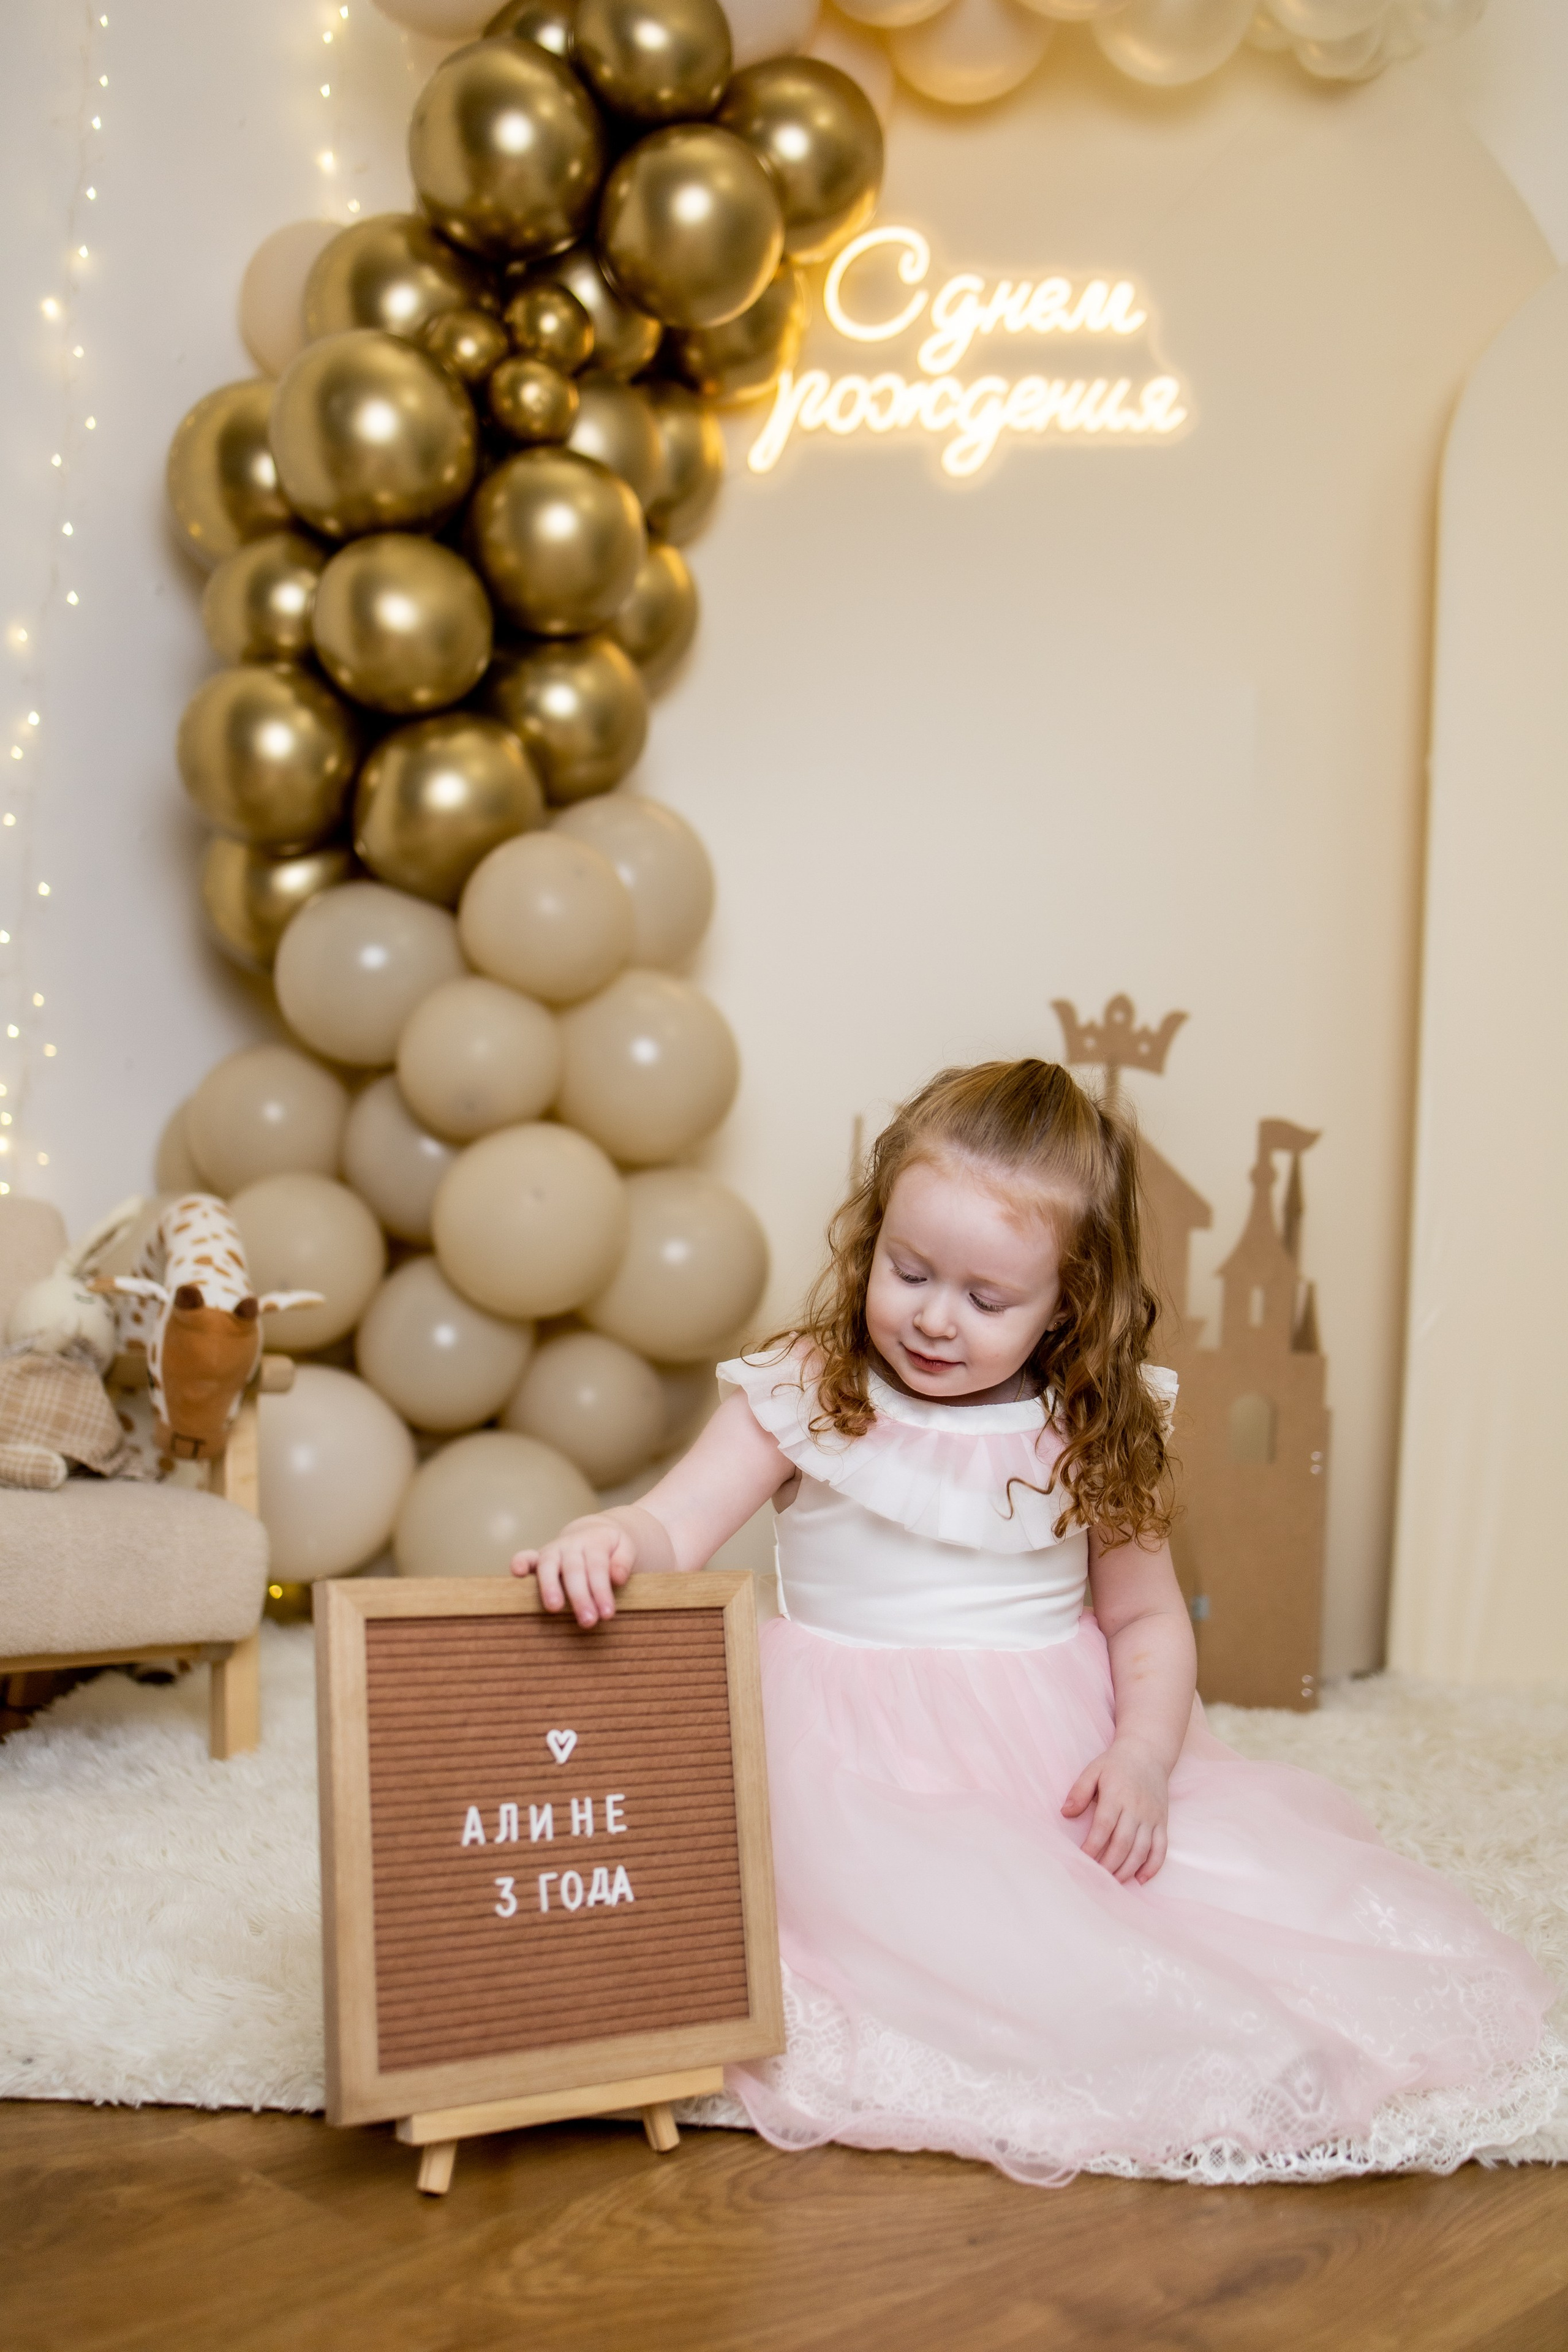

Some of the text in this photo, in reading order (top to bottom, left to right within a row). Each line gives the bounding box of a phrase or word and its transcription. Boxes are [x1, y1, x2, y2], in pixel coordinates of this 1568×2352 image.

[823, 225, 1148, 375] С днем
[747, 369, 1188, 478] рождения
[461, 1793, 628, 1847] АЛИНЕ
[494, 1864, 635, 1918] 3 ГОДА
